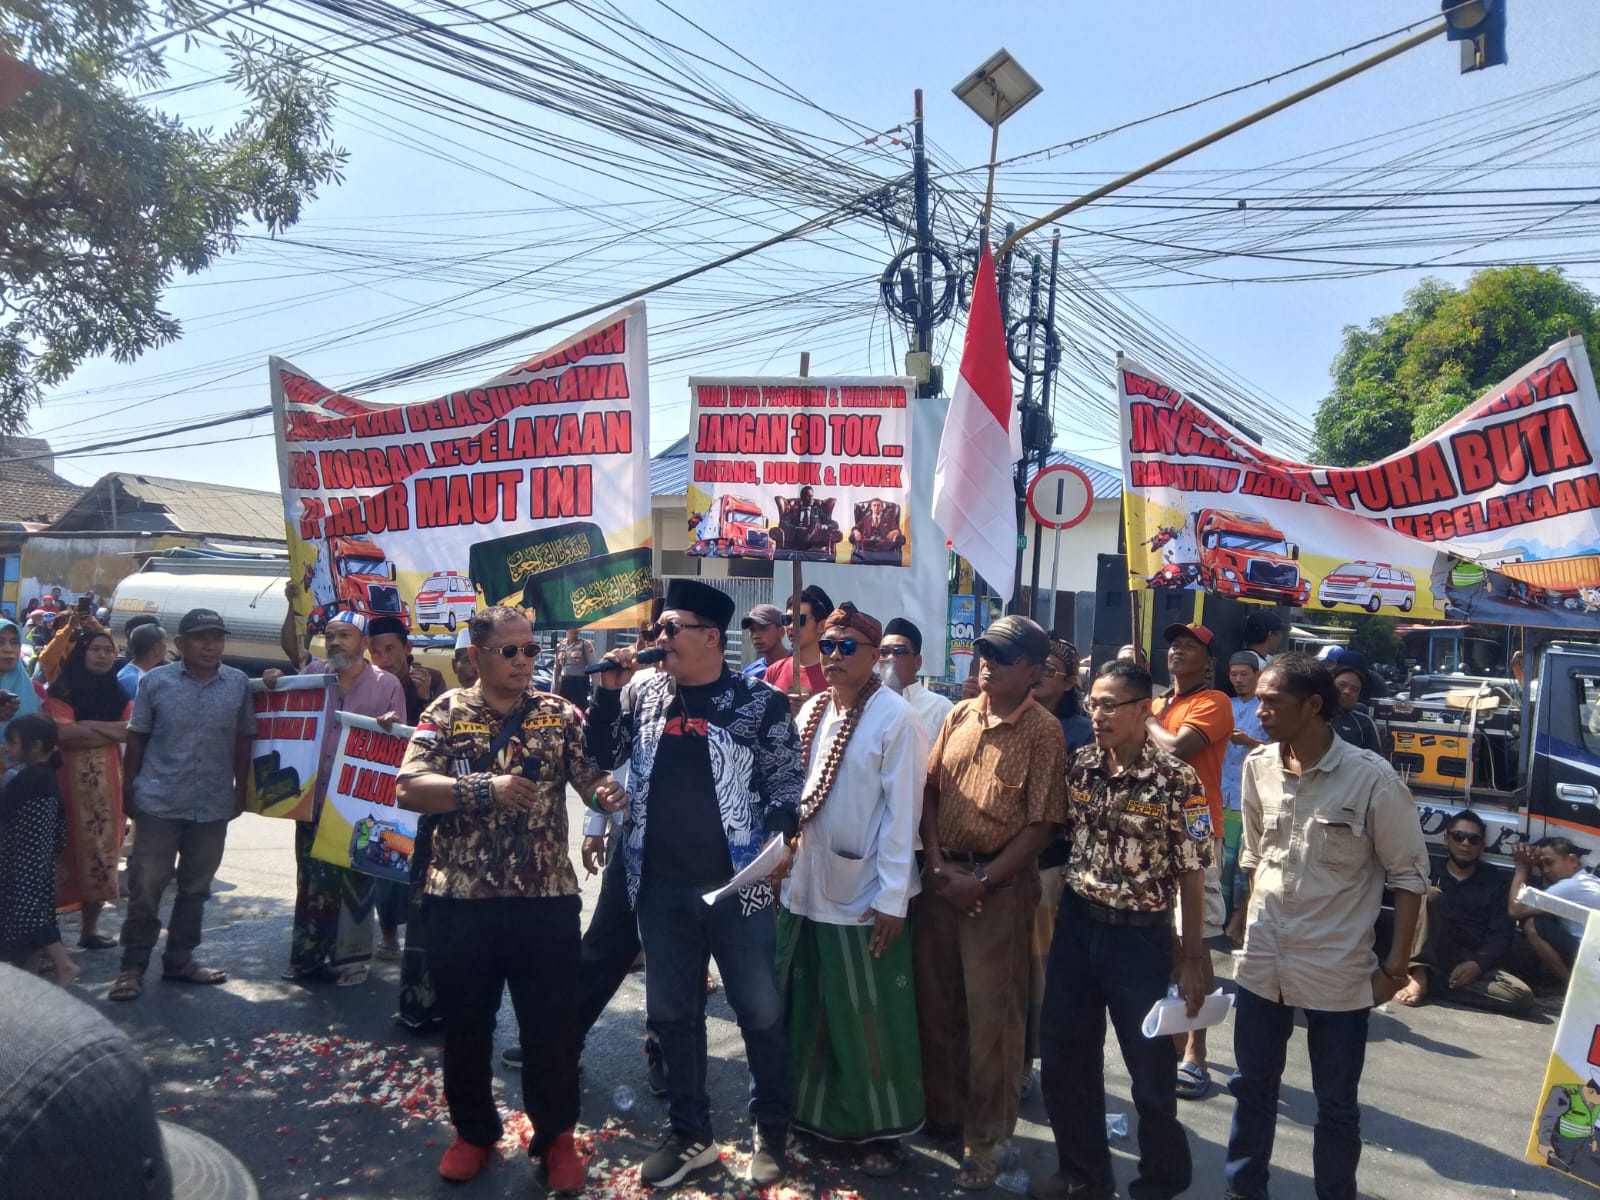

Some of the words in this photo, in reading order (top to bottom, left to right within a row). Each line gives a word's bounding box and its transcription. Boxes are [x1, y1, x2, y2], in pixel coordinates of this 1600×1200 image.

[829, 386, 839, 407] &
[695, 413, 789, 455] JANGAN
[791, 413, 826, 456] 3D
[1450, 403, 1594, 495] BUTA
[319, 442, 430, 489] KORBAN
[694, 460, 760, 485] DATANG,
[763, 461, 822, 485] DUDUK
[824, 465, 837, 486] &
[839, 463, 904, 488] DUWEK
[324, 482, 410, 538] JALUR
[415, 468, 523, 529] MAUT
[530, 464, 593, 520] INI
[1392, 473, 1600, 542] KECELAKAAN
[337, 763, 357, 795] DI
